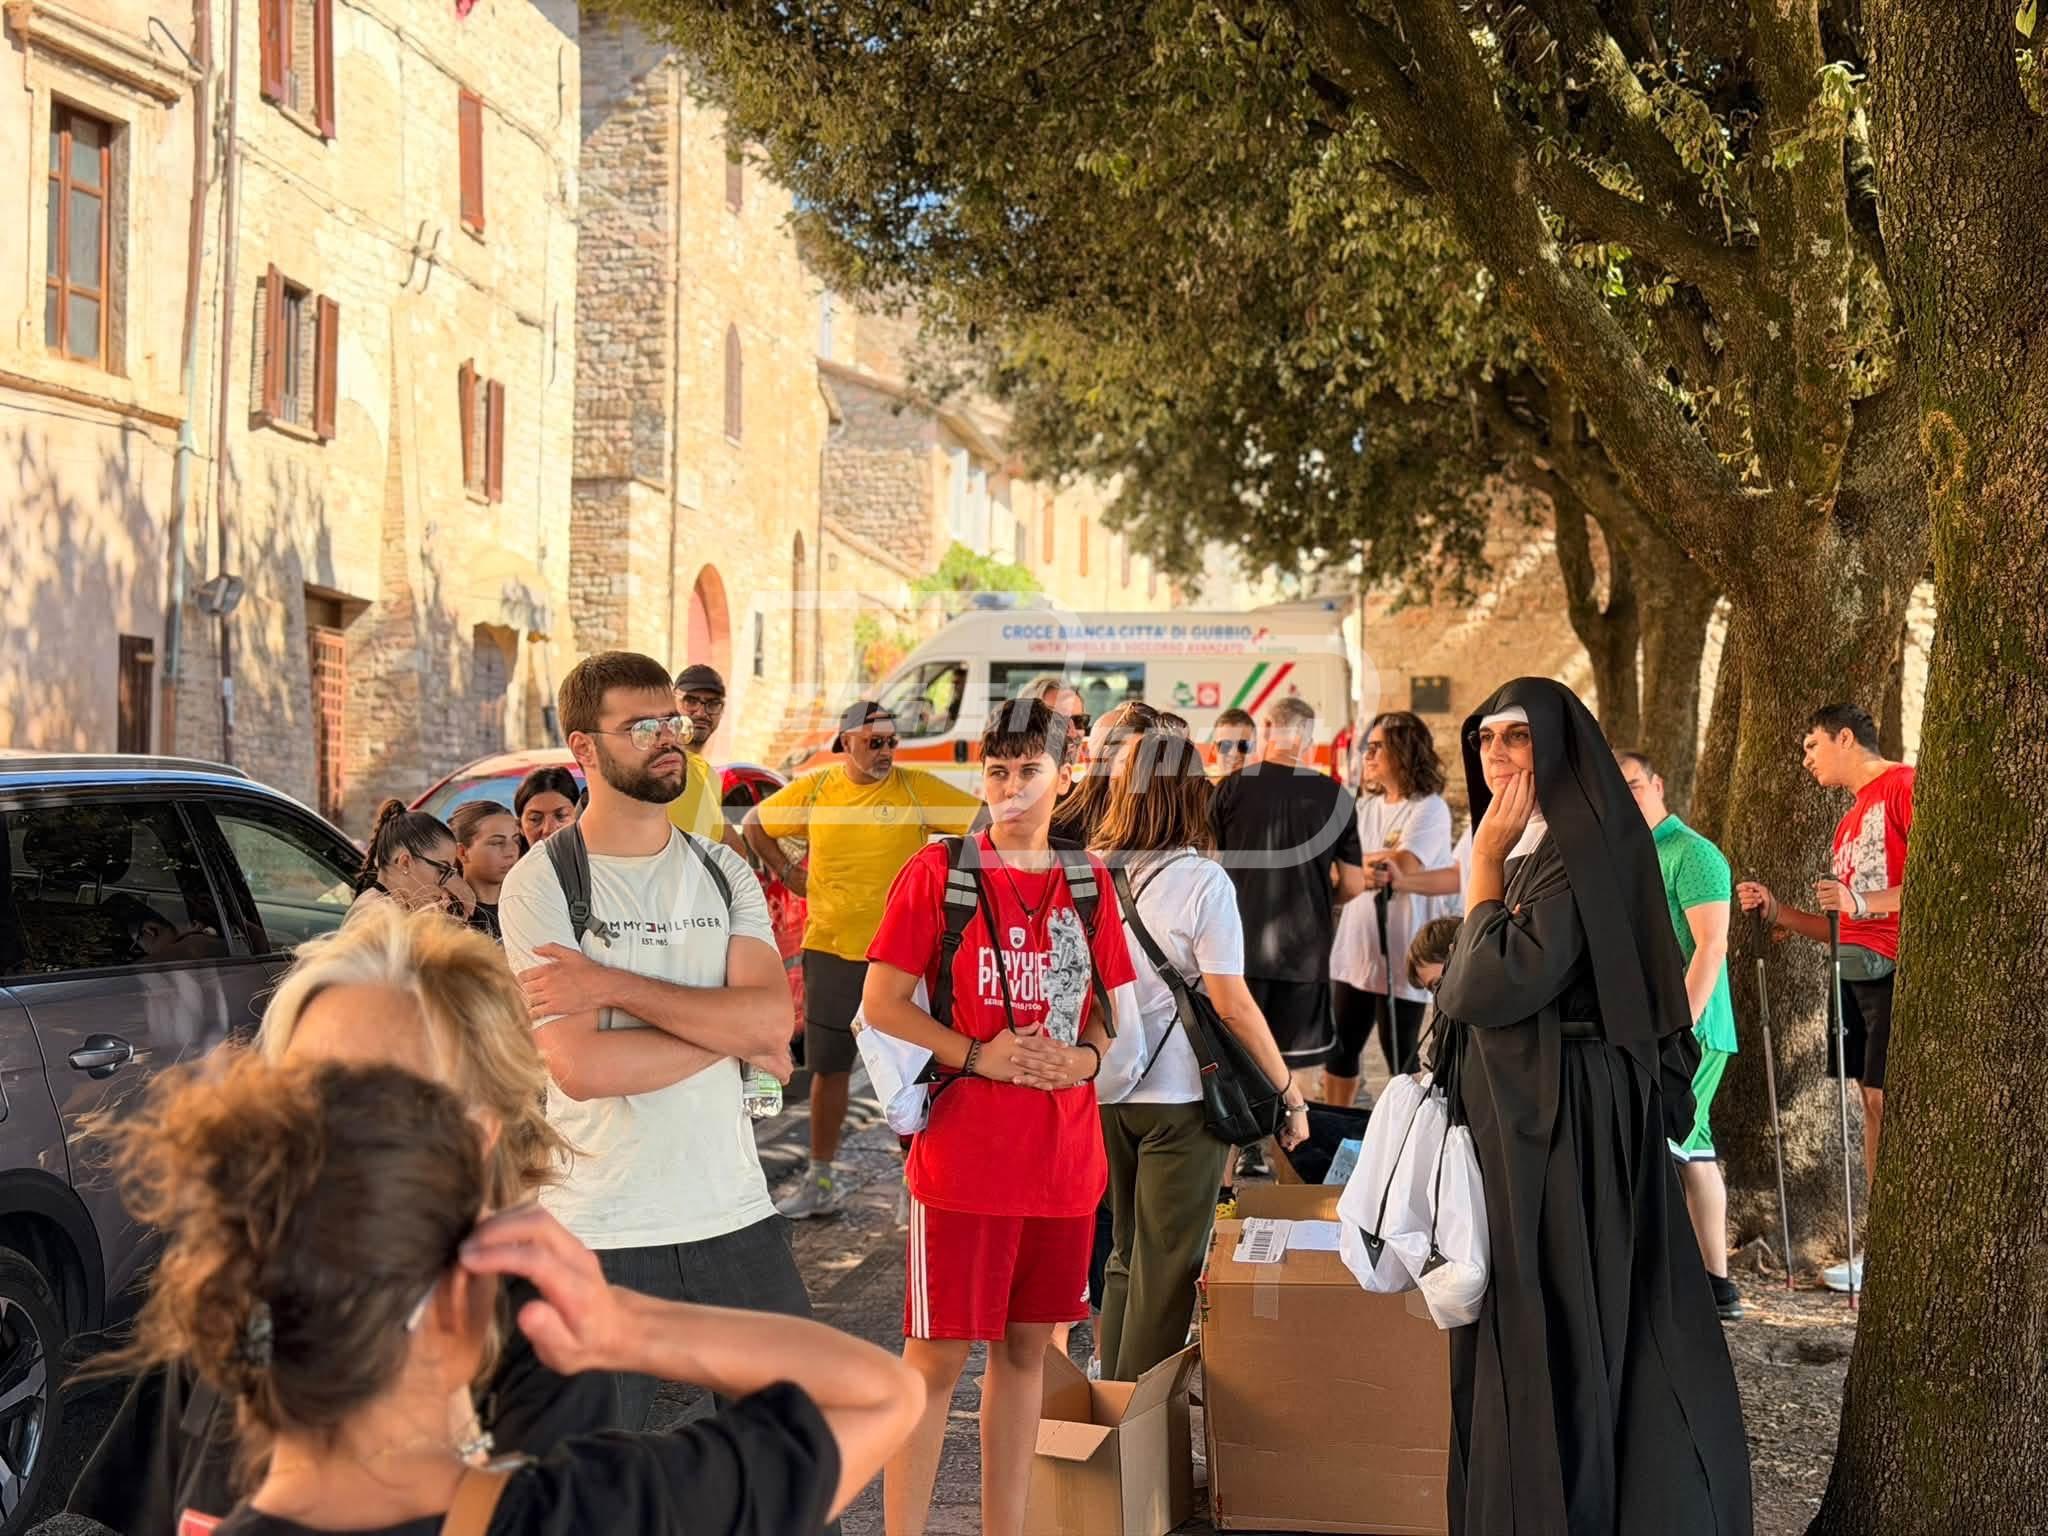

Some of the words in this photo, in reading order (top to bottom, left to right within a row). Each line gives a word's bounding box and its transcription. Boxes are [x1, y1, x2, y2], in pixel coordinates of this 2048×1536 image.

[1002, 624, 1052, 639] CROCE
[1058, 624, 1117, 639] BIANCA
[1171, 624, 1187, 639] DI
[1191, 624, 1251, 640] GUBBIO
[610, 920, 642, 932] MMY
[657, 917, 722, 933] HILFIGER
